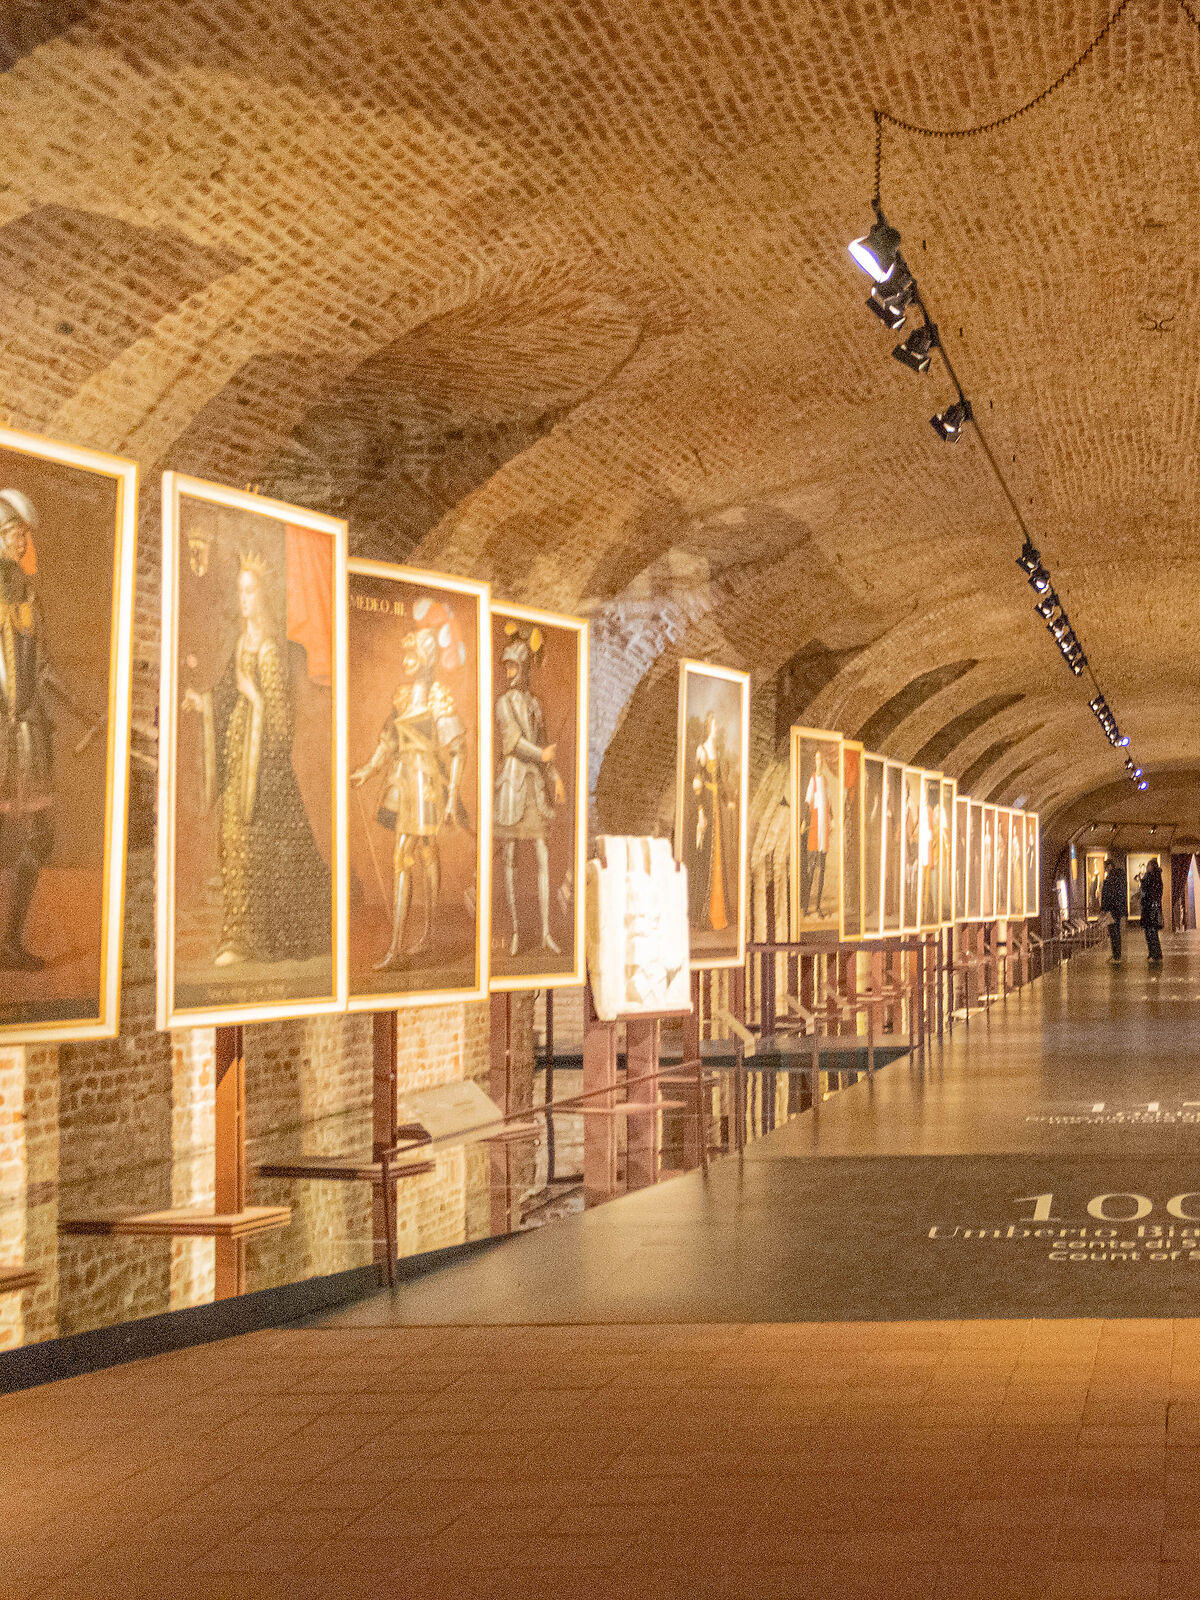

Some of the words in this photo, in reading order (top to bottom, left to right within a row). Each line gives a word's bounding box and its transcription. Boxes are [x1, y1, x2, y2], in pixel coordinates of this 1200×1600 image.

[928, 1226, 1118, 1239] Umberto
[1052, 1239, 1137, 1249] conte
[1145, 1239, 1171, 1249] di
[1049, 1251, 1141, 1261] Count
[1150, 1251, 1181, 1261] of
